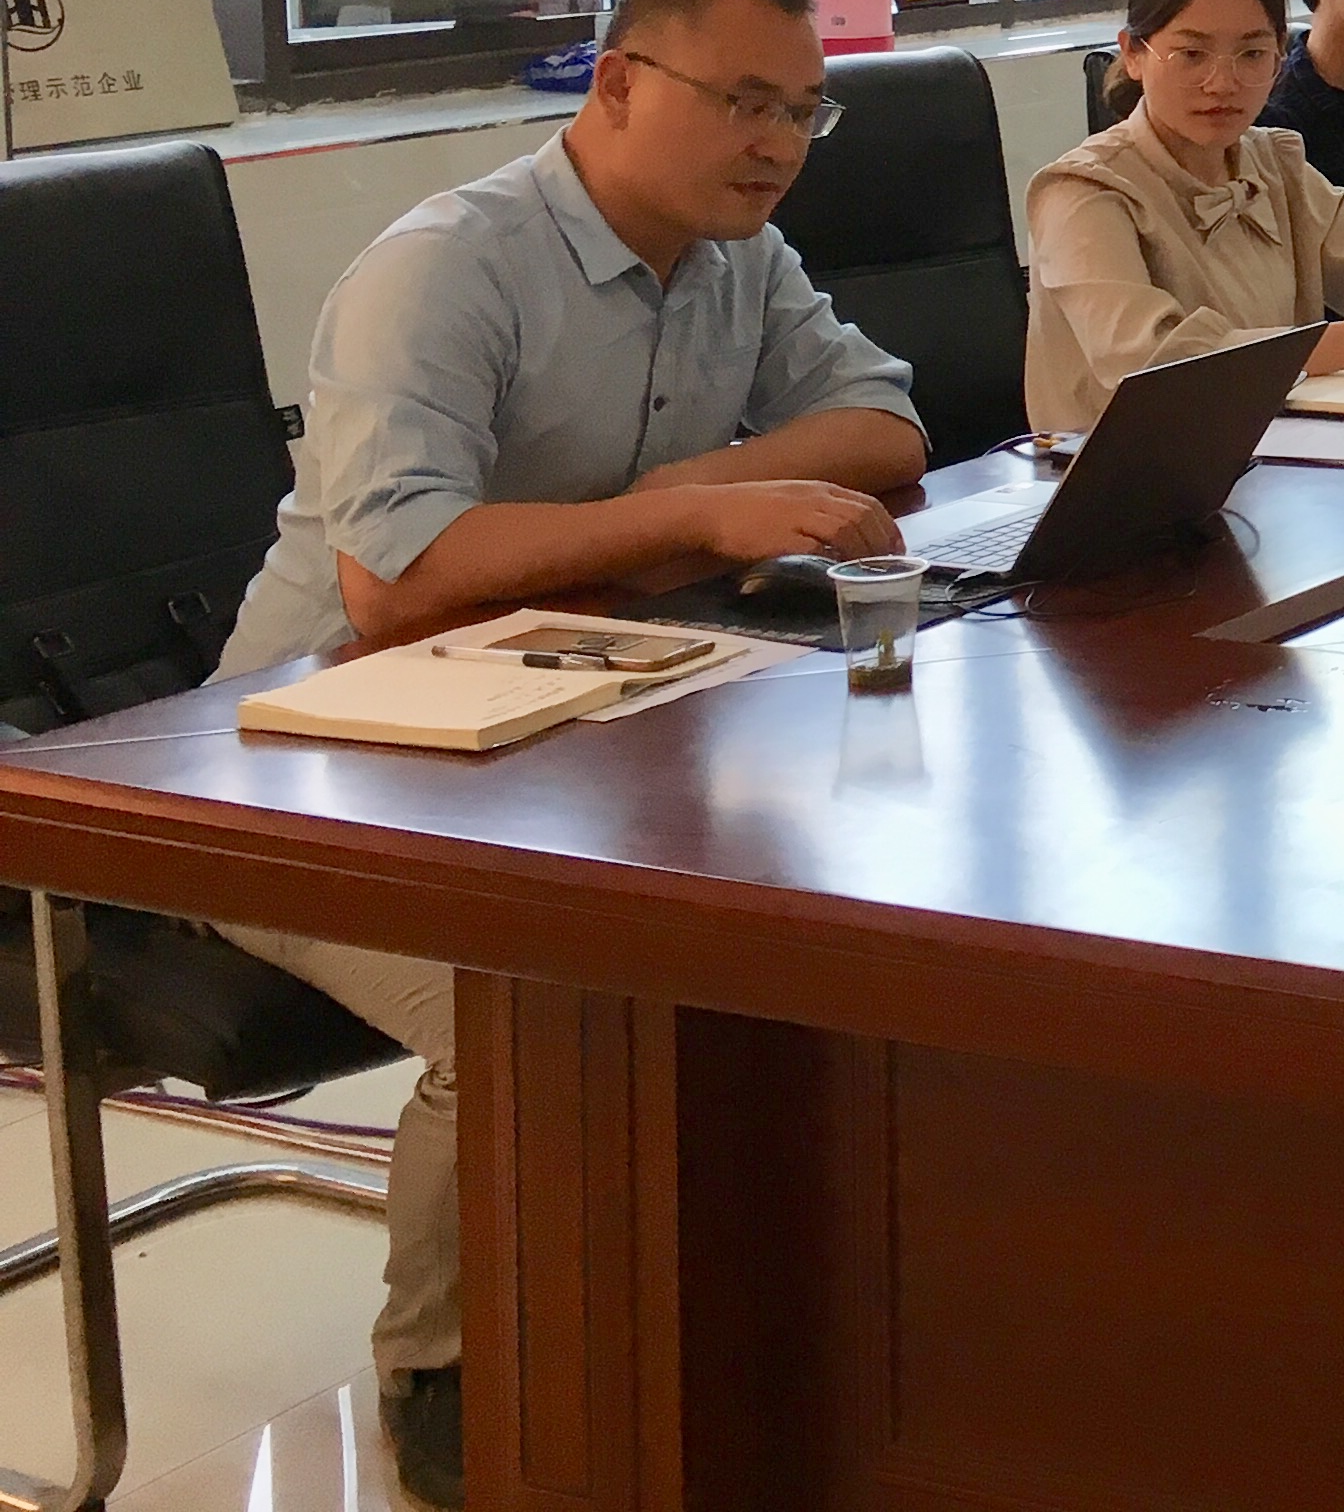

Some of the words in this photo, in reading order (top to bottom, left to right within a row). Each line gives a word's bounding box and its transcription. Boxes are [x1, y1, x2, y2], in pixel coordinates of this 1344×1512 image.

[8, 69, 145, 103] 理示范企业
